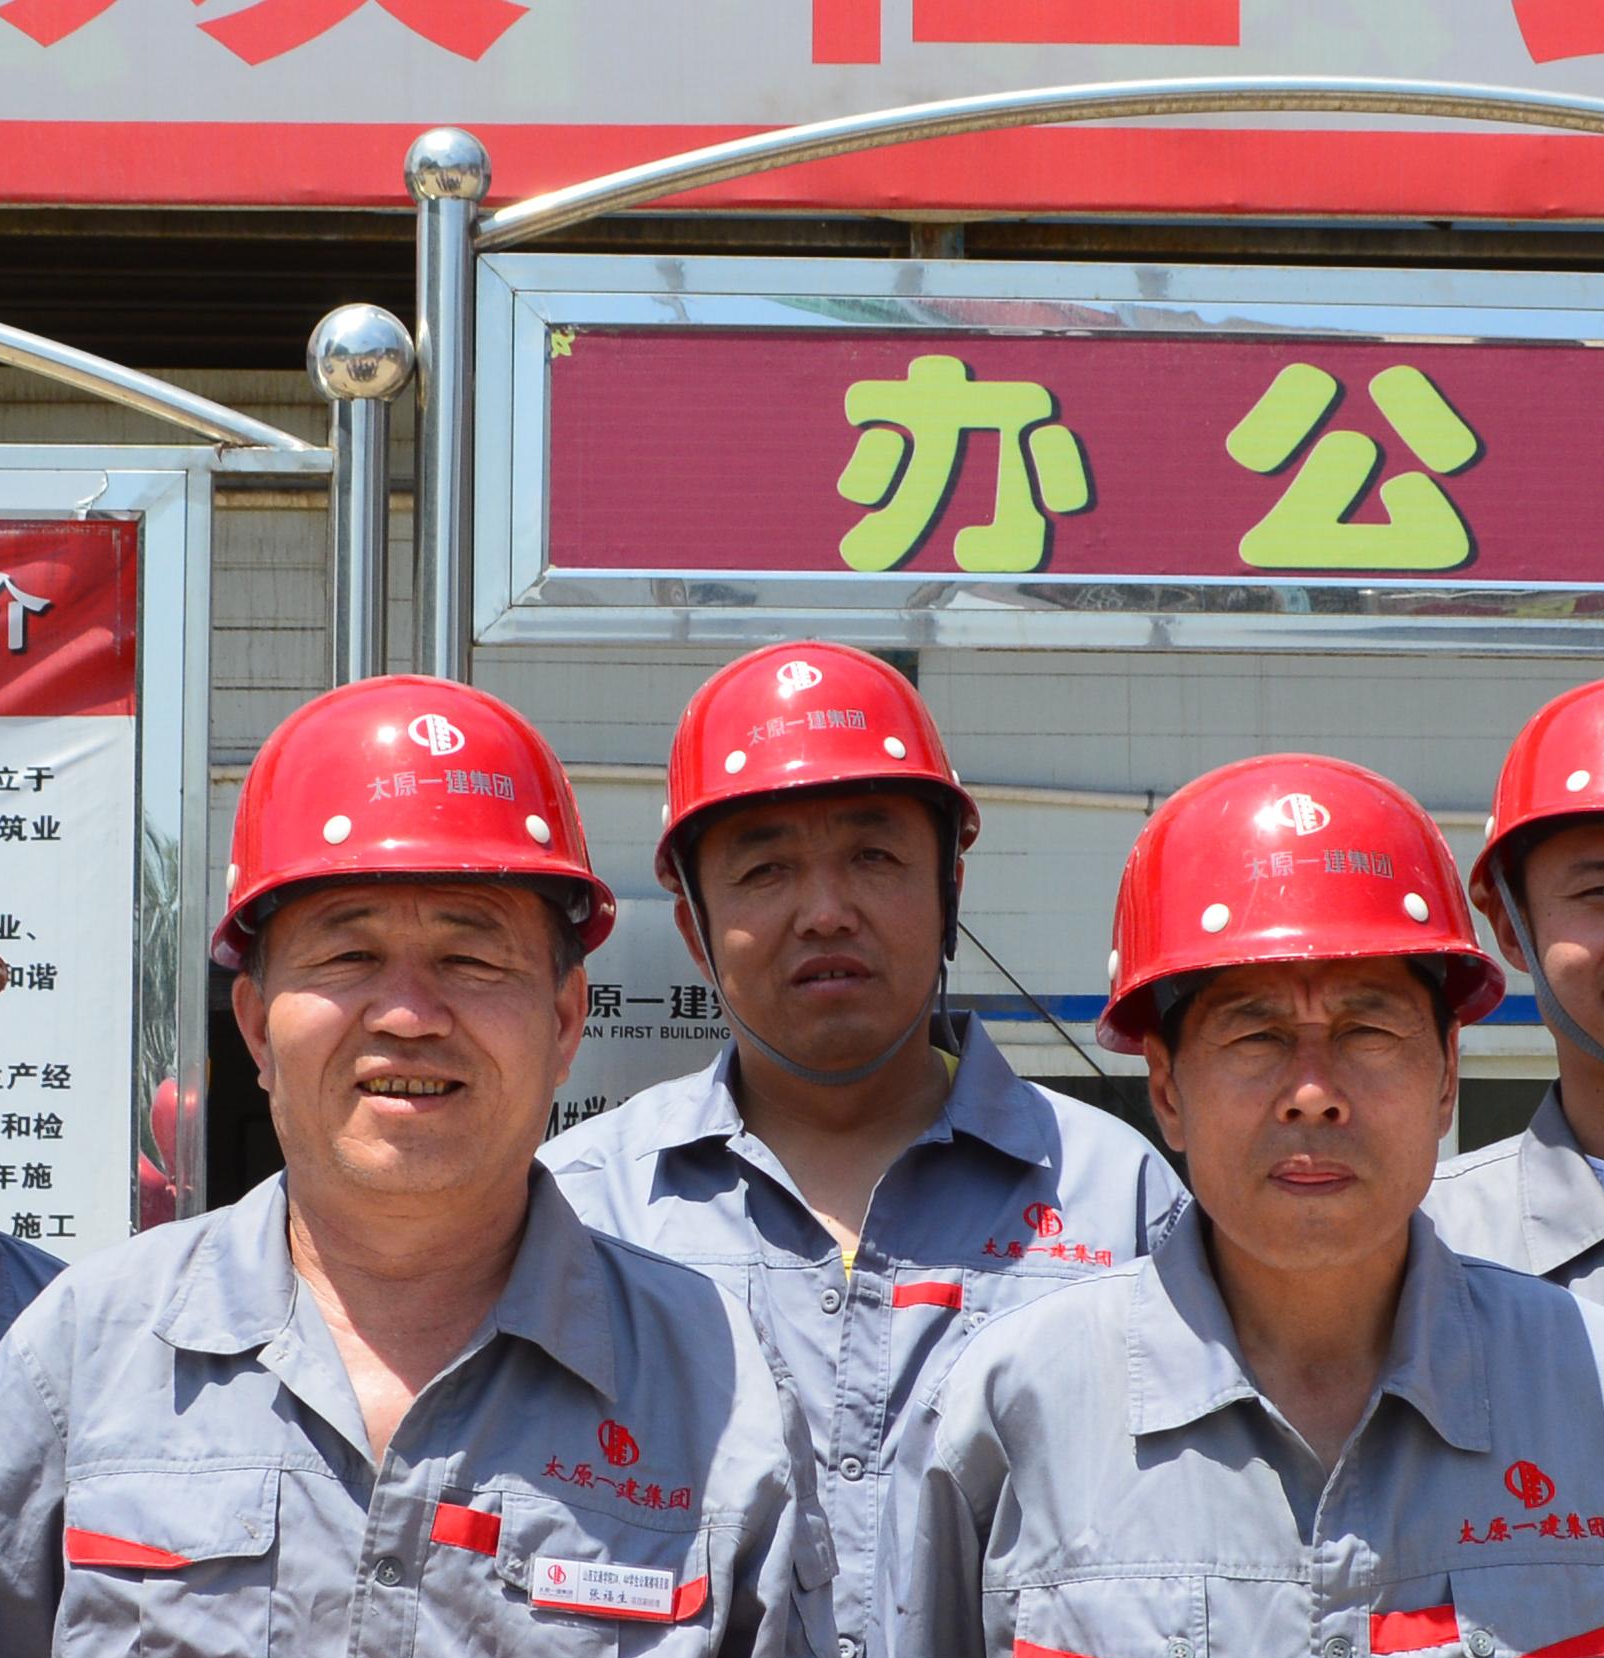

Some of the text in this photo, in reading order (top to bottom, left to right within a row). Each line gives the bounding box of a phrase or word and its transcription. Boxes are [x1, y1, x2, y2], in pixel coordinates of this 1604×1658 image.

[747, 709, 867, 747] 太原一建集团
[367, 769, 516, 802] 太原一建集团
[1244, 849, 1395, 880] 太原一建集团
[611, 1026, 653, 1039] FIRST
[660, 1026, 731, 1040] BUILDING
[982, 1237, 1112, 1268] 太原一建集团
[541, 1456, 692, 1512] 太原一建集团
